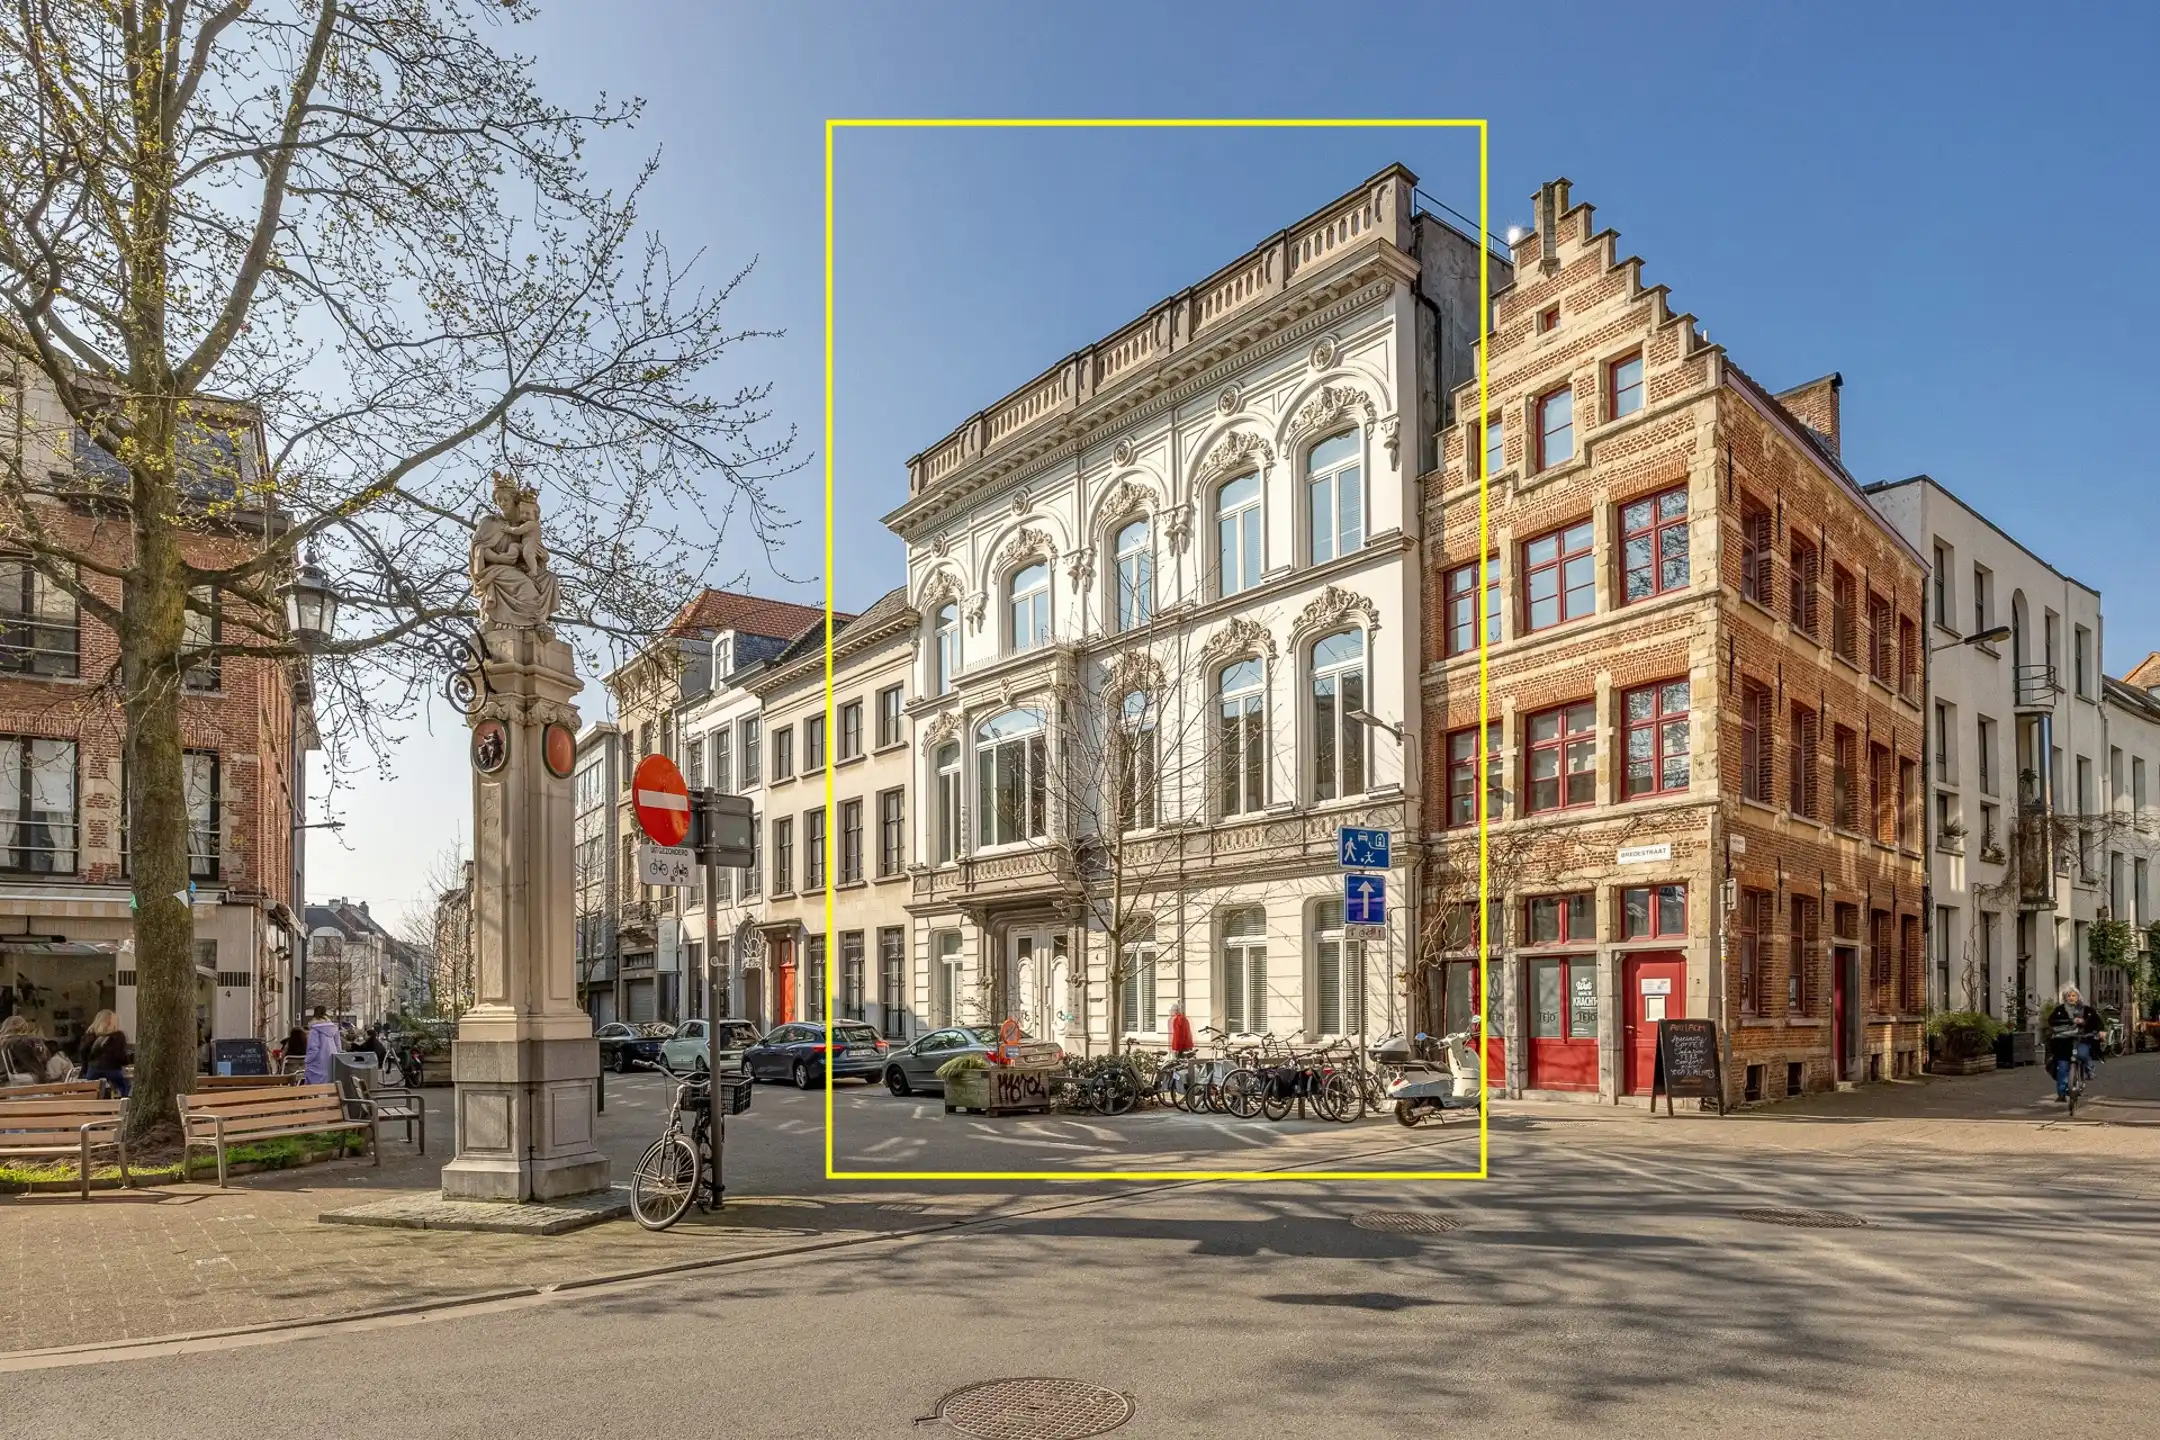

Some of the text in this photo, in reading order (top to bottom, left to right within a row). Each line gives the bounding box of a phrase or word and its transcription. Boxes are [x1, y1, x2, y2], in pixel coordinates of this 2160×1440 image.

[650, 846, 688, 857] UITGEZONDERD
[1621, 847, 1667, 858] BREDESTRAAT
[225, 990, 231, 998] 4
[1572, 996, 1598, 1008] KRACHT
